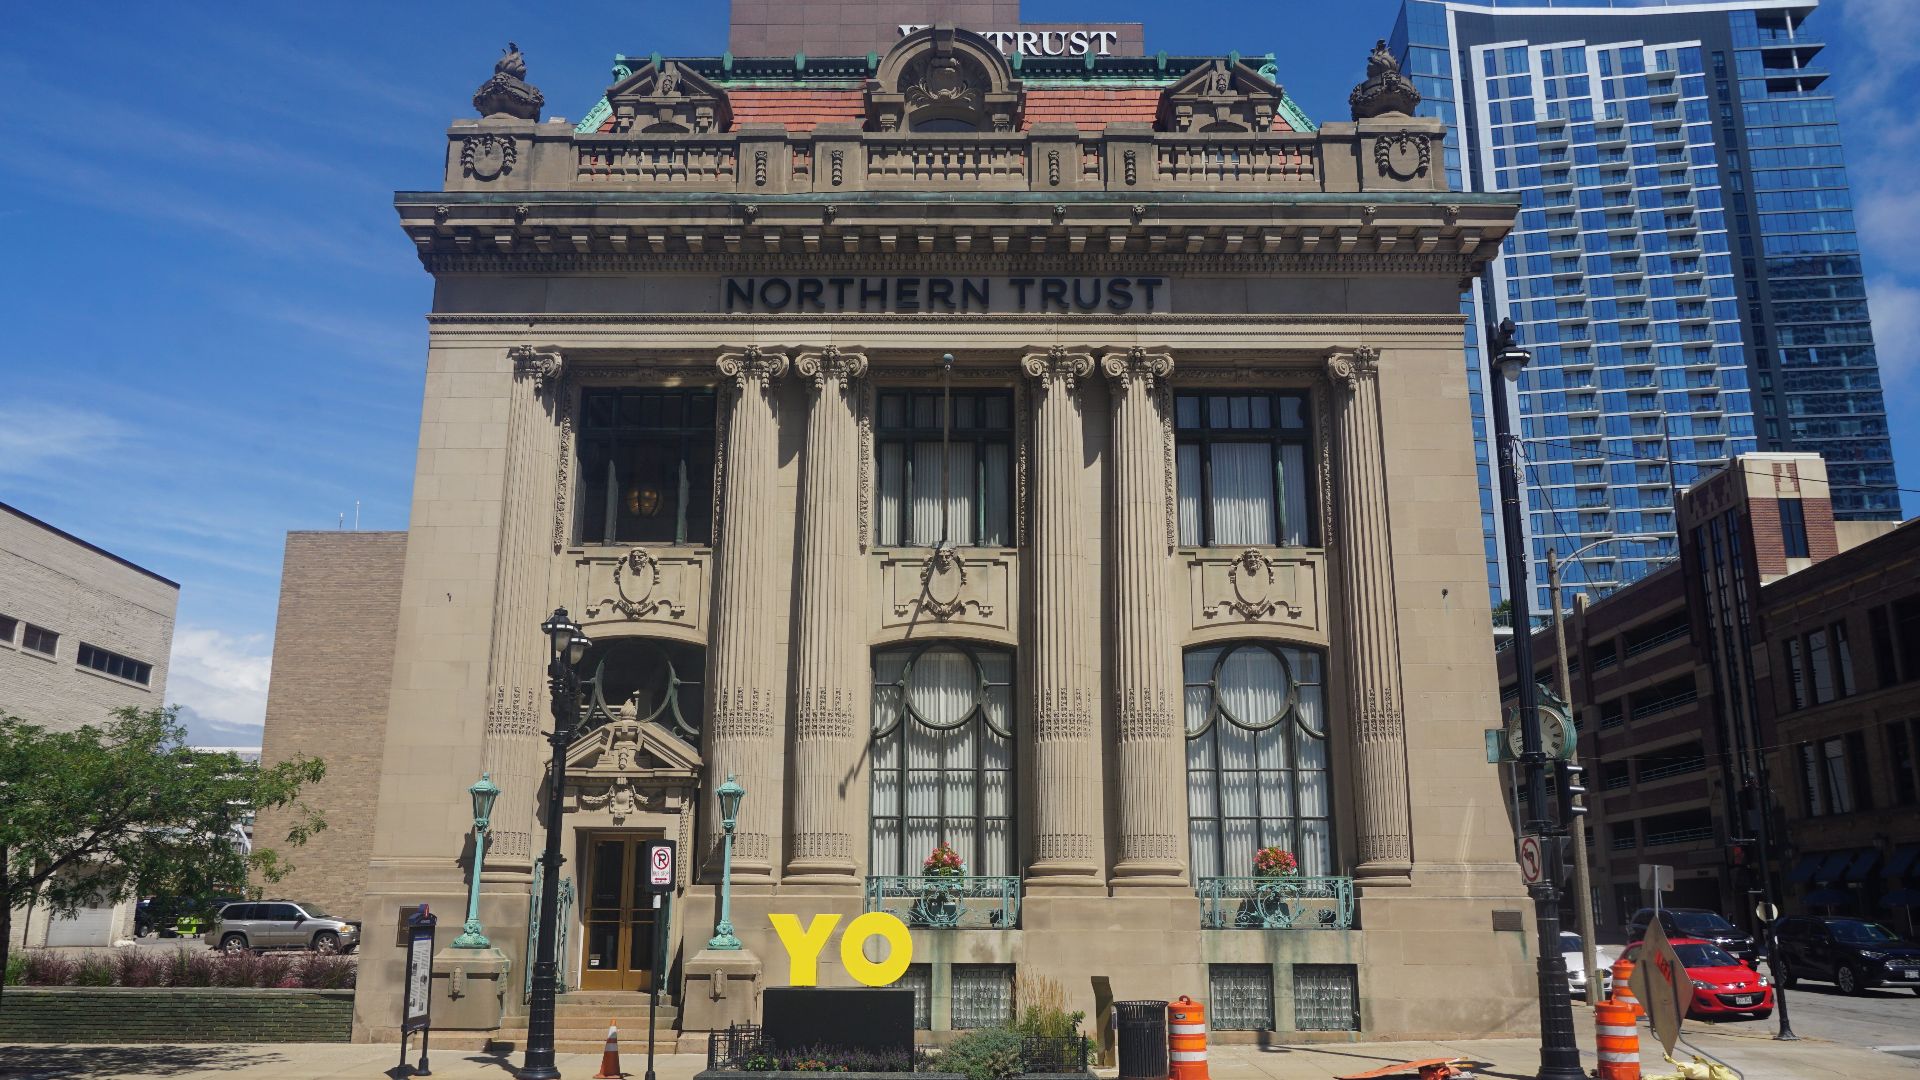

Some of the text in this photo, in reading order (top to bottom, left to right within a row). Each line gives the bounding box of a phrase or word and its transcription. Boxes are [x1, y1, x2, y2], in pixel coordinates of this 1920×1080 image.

[726, 277, 1163, 309] NORTHERN TRUST
[768, 912, 914, 986] YO
